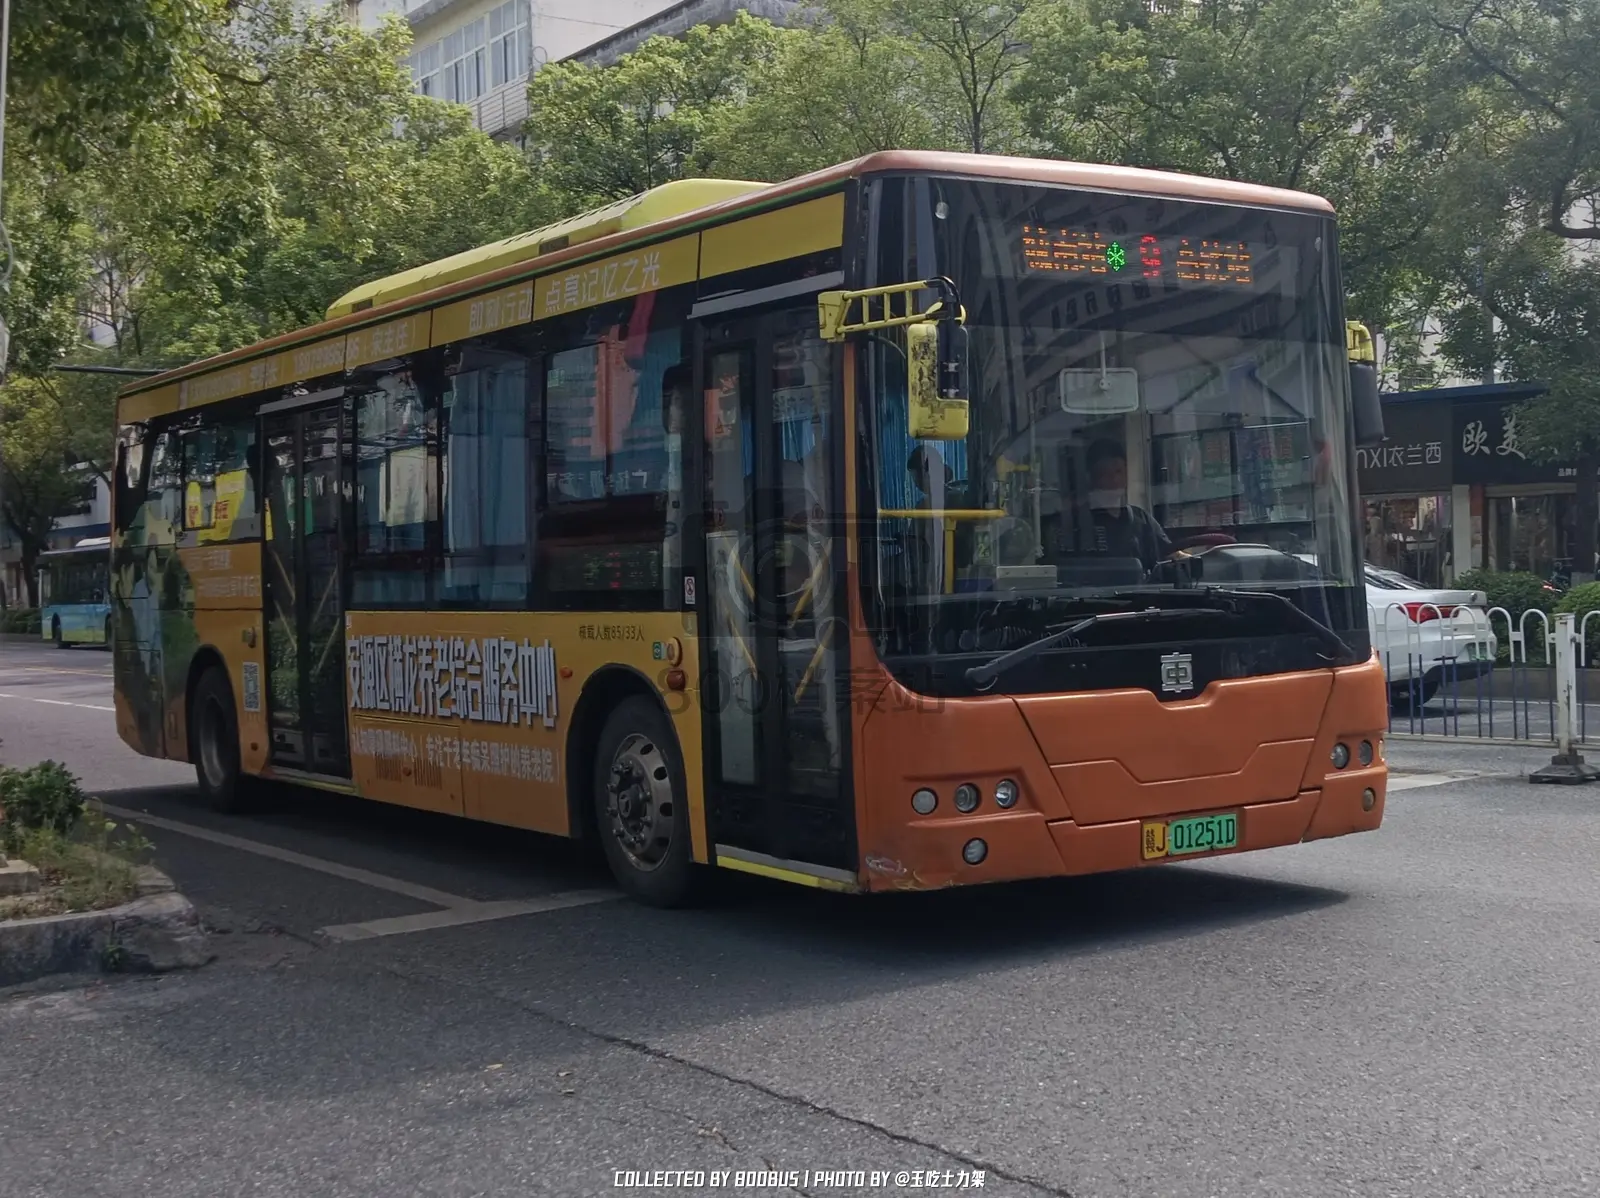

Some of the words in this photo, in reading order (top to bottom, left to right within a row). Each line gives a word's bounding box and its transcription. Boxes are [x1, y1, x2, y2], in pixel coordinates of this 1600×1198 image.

[469, 287, 533, 332] 即刻行动
[545, 250, 660, 313] 点亮记忆之光
[347, 634, 559, 729] 安源区横龙养老综合服务中心
